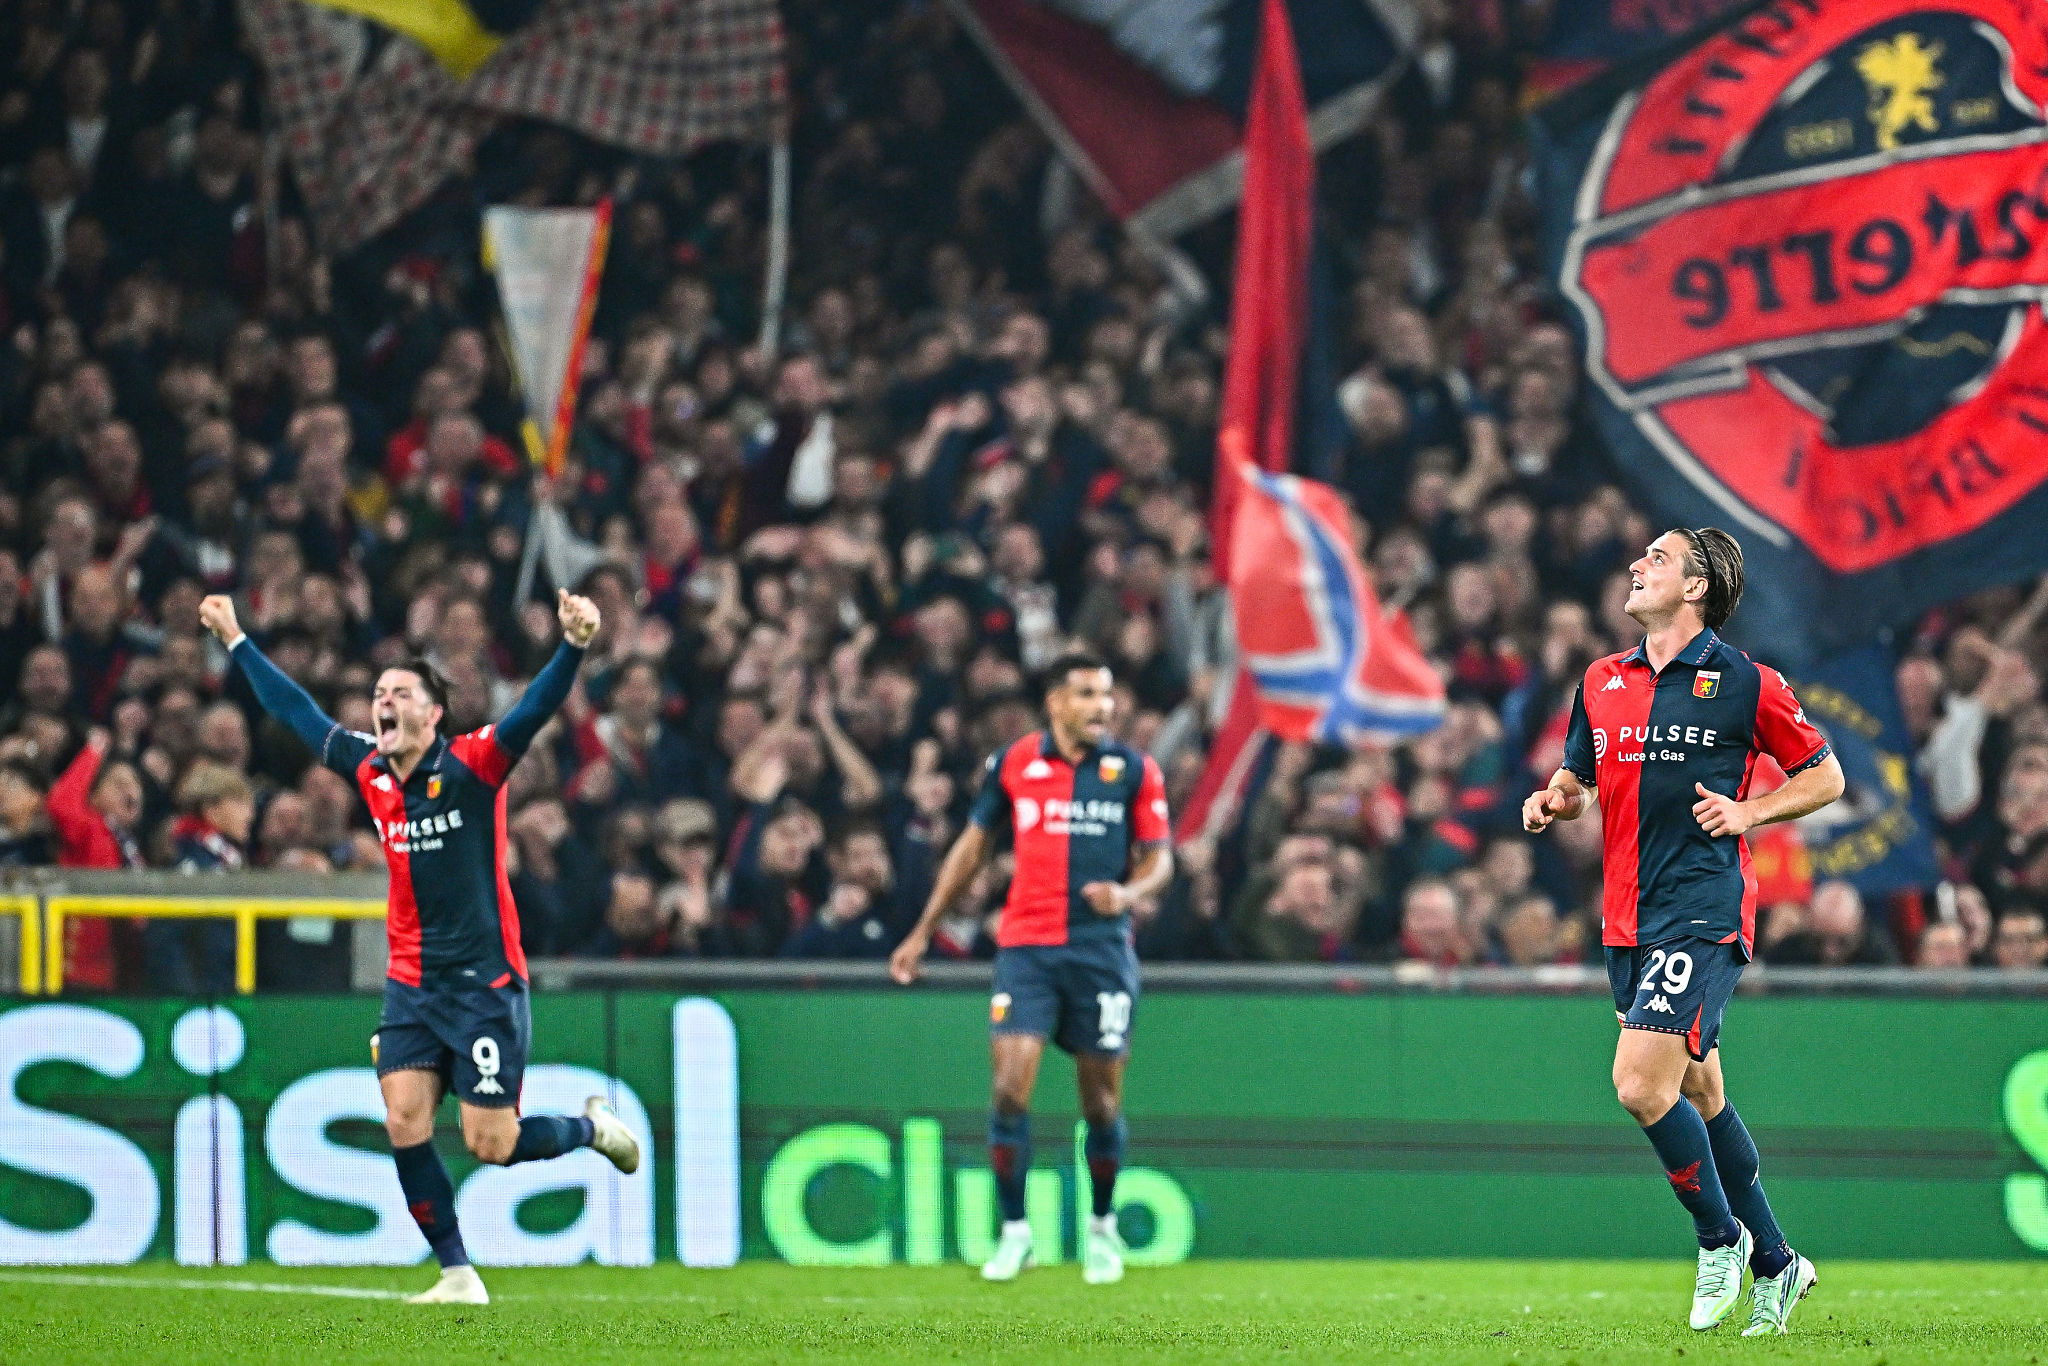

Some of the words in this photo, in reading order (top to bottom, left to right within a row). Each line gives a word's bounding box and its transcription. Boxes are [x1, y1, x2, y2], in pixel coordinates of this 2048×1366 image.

[1618, 751, 1647, 762] Luce
[1649, 752, 1658, 761] e
[1660, 749, 1685, 762] Gas
[1619, 724, 1717, 747] PULSEE
[1639, 949, 1693, 995] 29
[472, 1036, 500, 1077] 9
[0, 998, 741, 1267] Sisal
[761, 1116, 1197, 1267] Club
